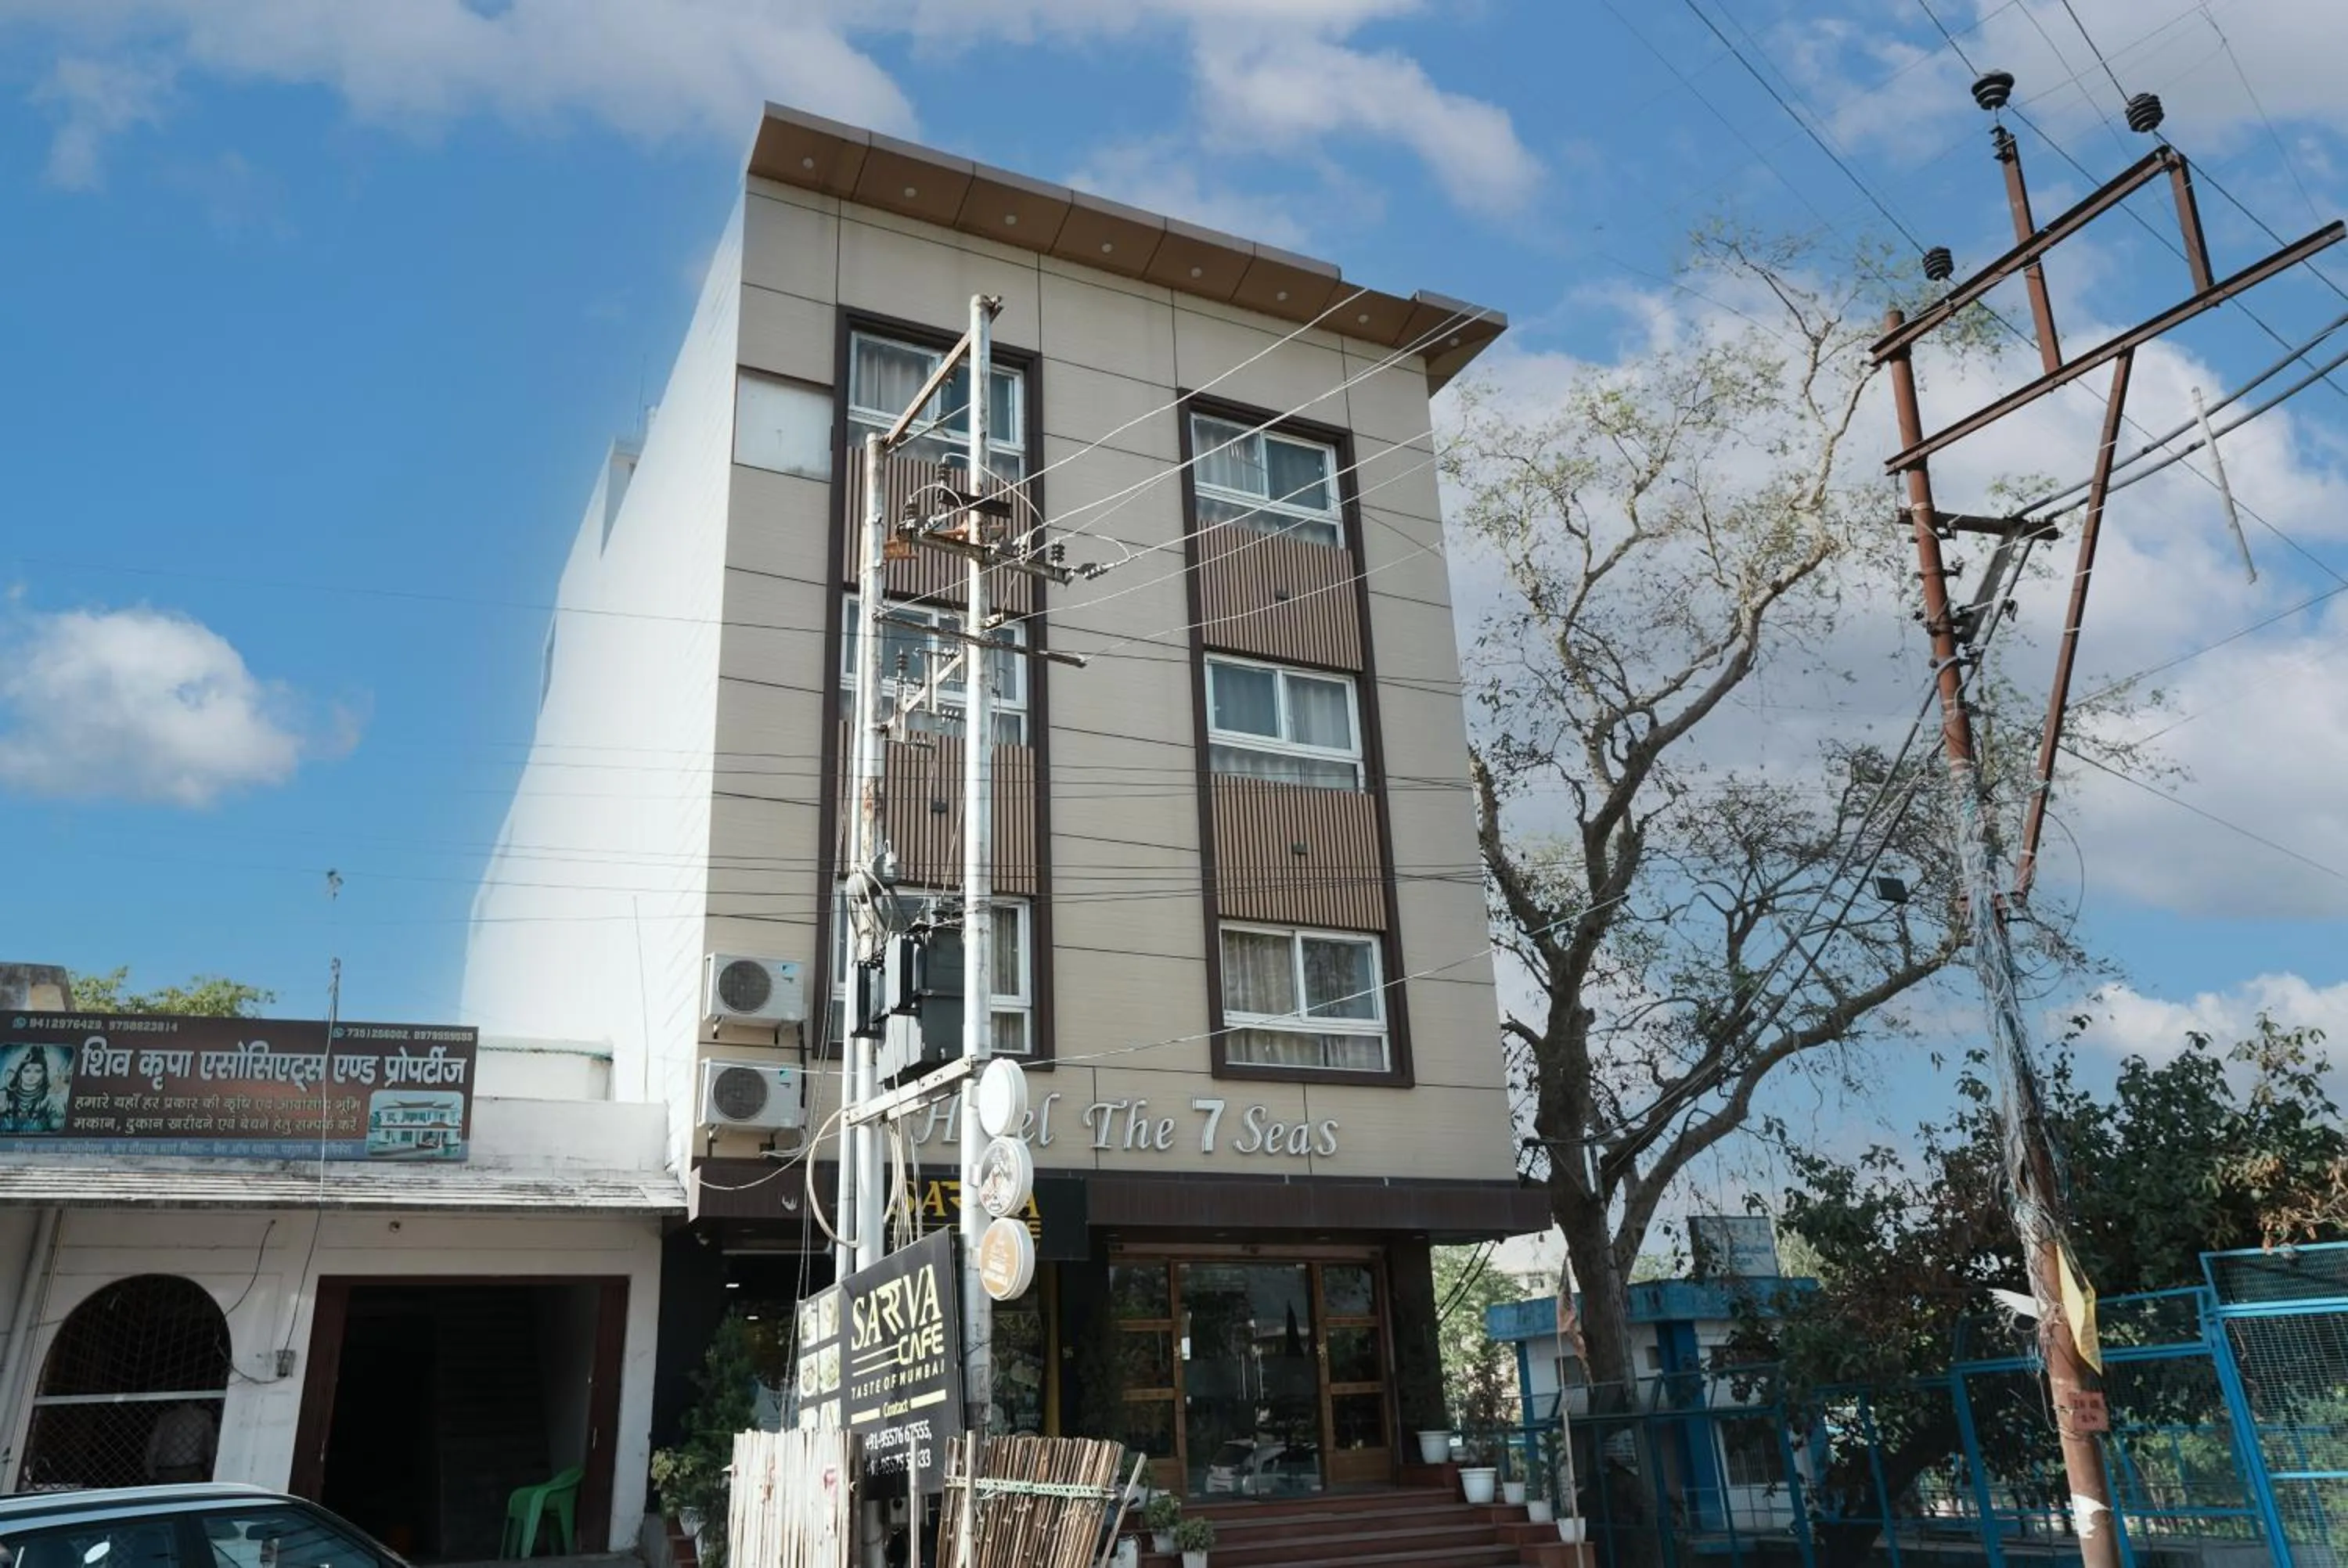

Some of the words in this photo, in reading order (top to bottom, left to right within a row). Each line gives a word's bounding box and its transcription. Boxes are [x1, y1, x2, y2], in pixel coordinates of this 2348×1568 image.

[81, 1035, 134, 1077] शिव
[139, 1049, 194, 1090] कृपा
[200, 1040, 326, 1092] एसोसिएट्स
[333, 1054, 379, 1084] एण्ड
[74, 1092, 110, 1110] हमारे
[142, 1096, 160, 1109] हर
[164, 1096, 198, 1109] प्रकार
[203, 1094, 220, 1109] की
[223, 1095, 251, 1113] कृषि
[914, 1090, 1061, 1147] Hel
[1083, 1099, 1174, 1150] The
[1192, 1098, 1226, 1153] 7
[1234, 1105, 1339, 1156] Seas
[125, 1117, 164, 1134] दुकान
[852, 1264, 943, 1352] SARVA
[898, 1322, 945, 1365] CAFE
[852, 1379, 880, 1401] TASTE
[884, 1373, 897, 1390] OF
[899, 1358, 945, 1386] MUMBAI
